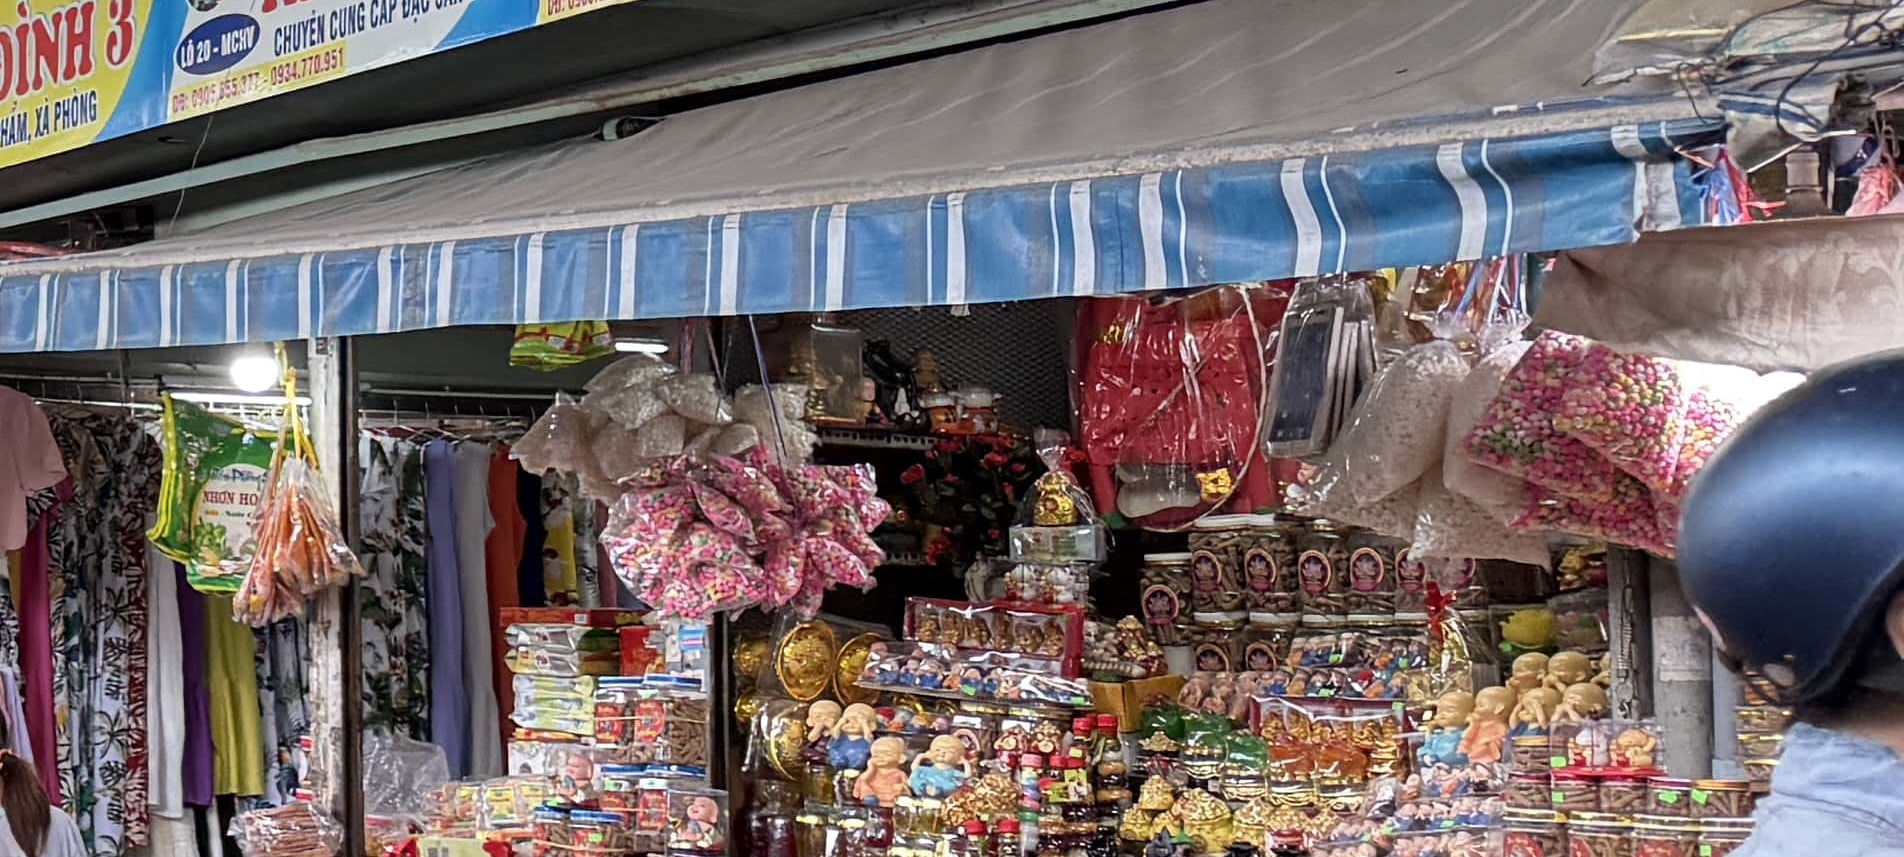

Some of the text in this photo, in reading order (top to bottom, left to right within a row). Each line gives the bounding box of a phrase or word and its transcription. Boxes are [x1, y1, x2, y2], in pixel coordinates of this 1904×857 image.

[106, 0, 136, 66] 3
[181, 39, 194, 68] LÔ
[196, 39, 211, 64] 20
[274, 10, 326, 57] CHUYÊN
[330, 2, 366, 41] CUNG
[36, 97, 50, 138] XÀ
[55, 88, 97, 132] PHÒNG
